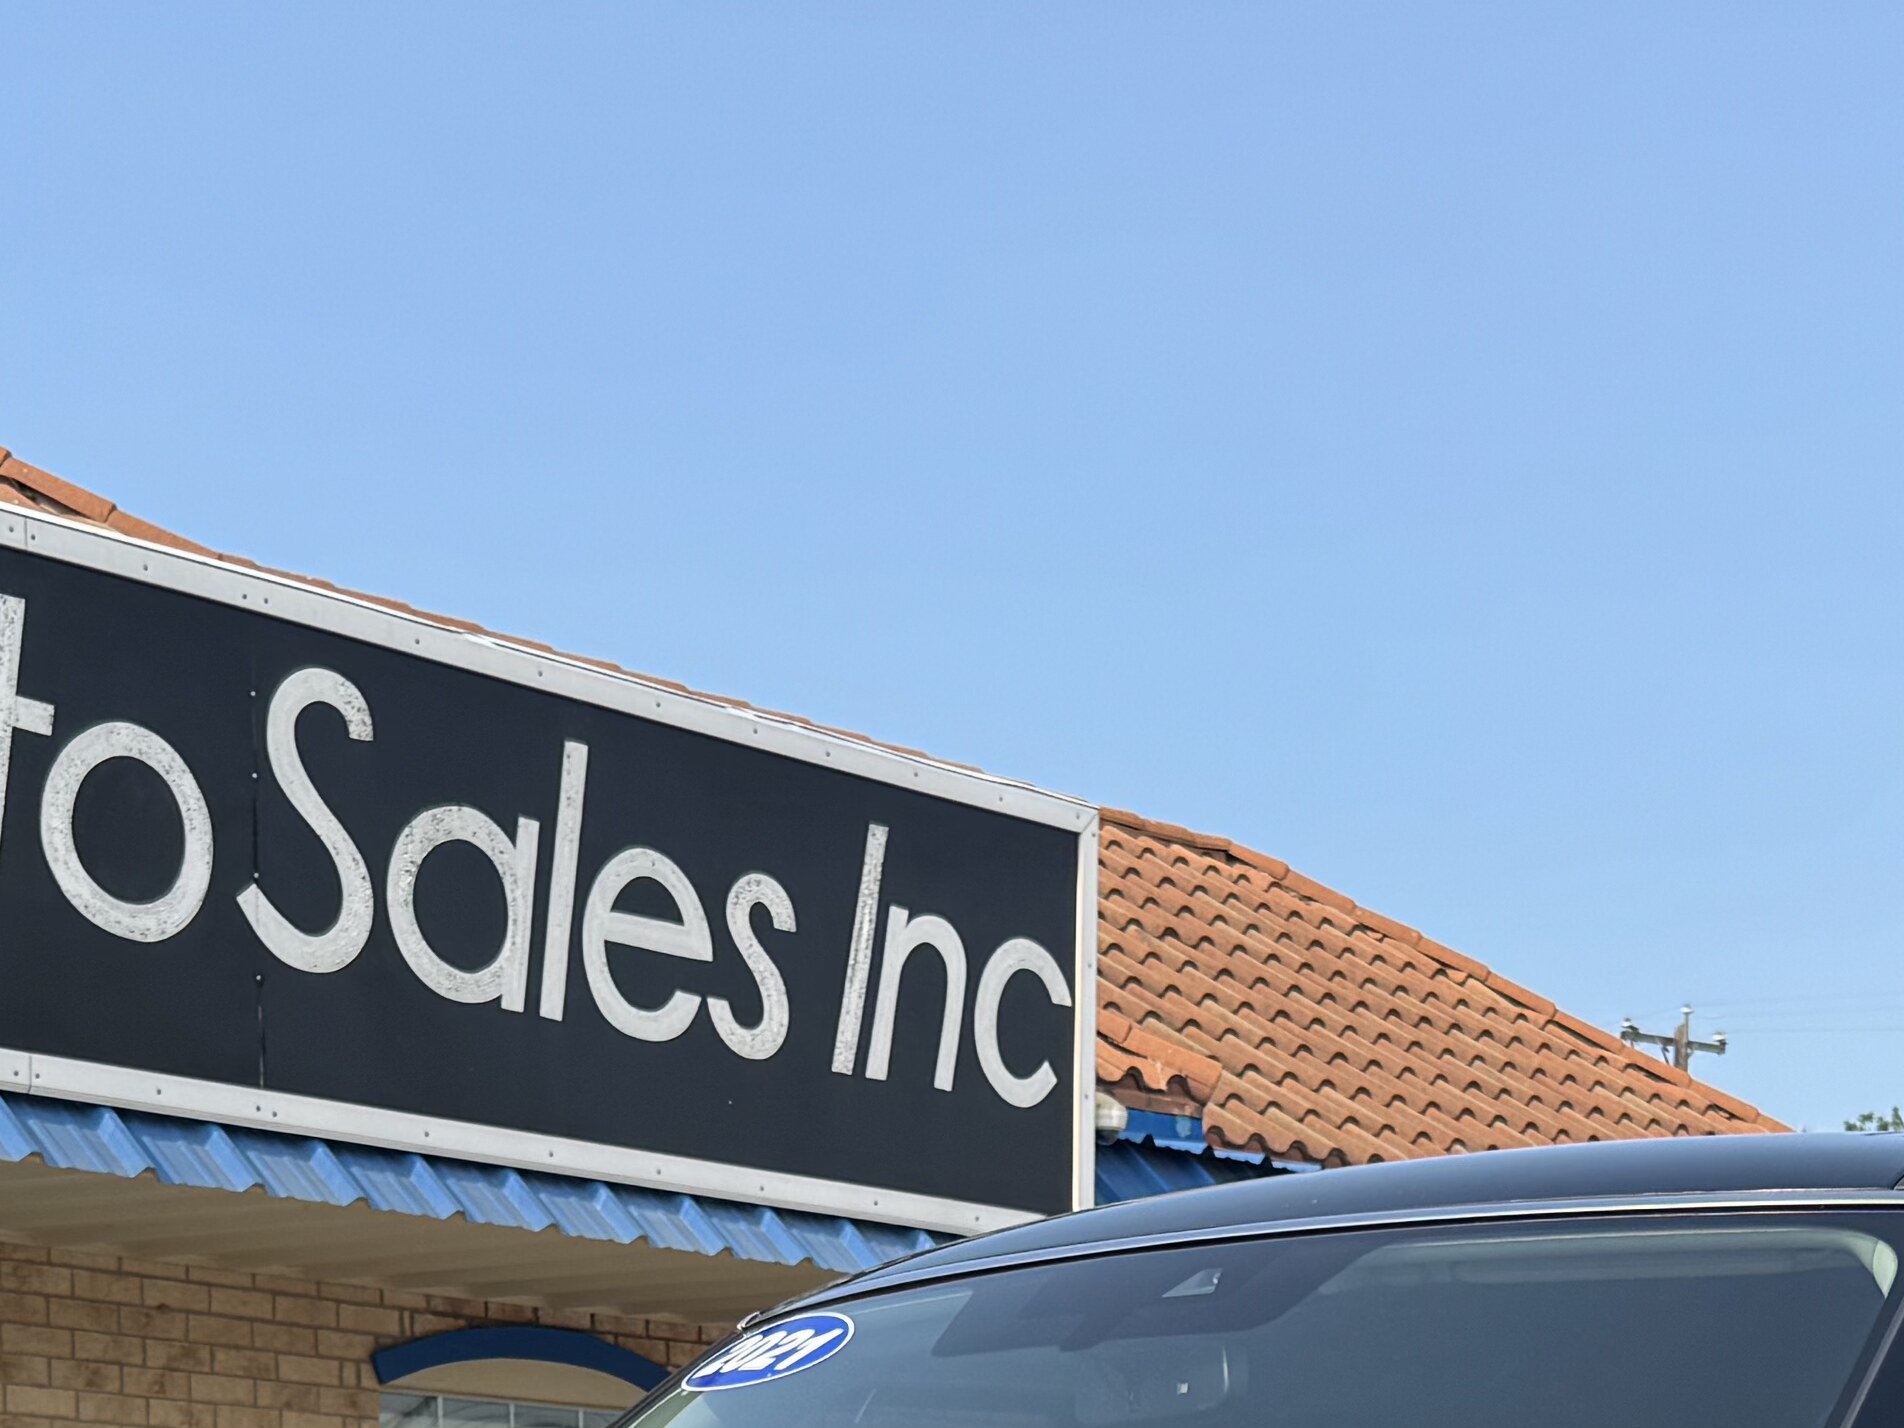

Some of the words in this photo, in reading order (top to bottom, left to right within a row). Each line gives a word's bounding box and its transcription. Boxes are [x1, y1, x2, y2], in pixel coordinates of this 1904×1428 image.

[236, 667, 798, 1061] Sales
[831, 824, 1073, 1108] Inc
[691, 1327, 845, 1373] 2021
